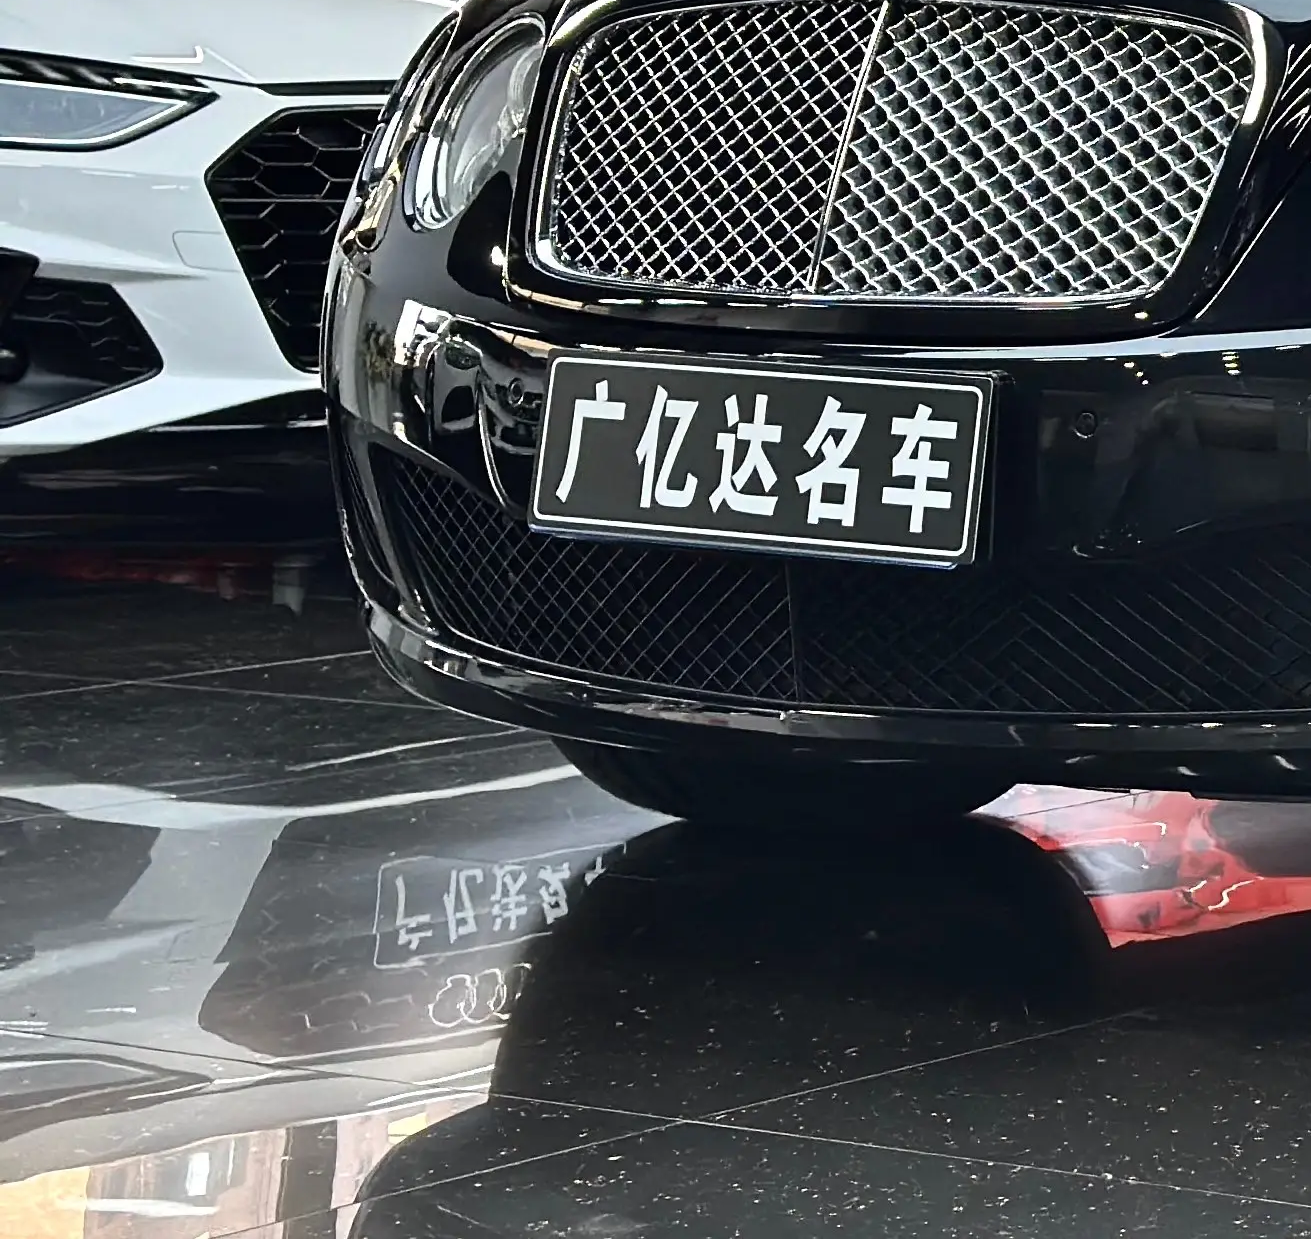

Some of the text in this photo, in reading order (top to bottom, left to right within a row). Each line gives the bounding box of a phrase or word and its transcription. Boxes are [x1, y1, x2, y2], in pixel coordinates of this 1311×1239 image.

[555, 379, 958, 534] 广亿达名车
